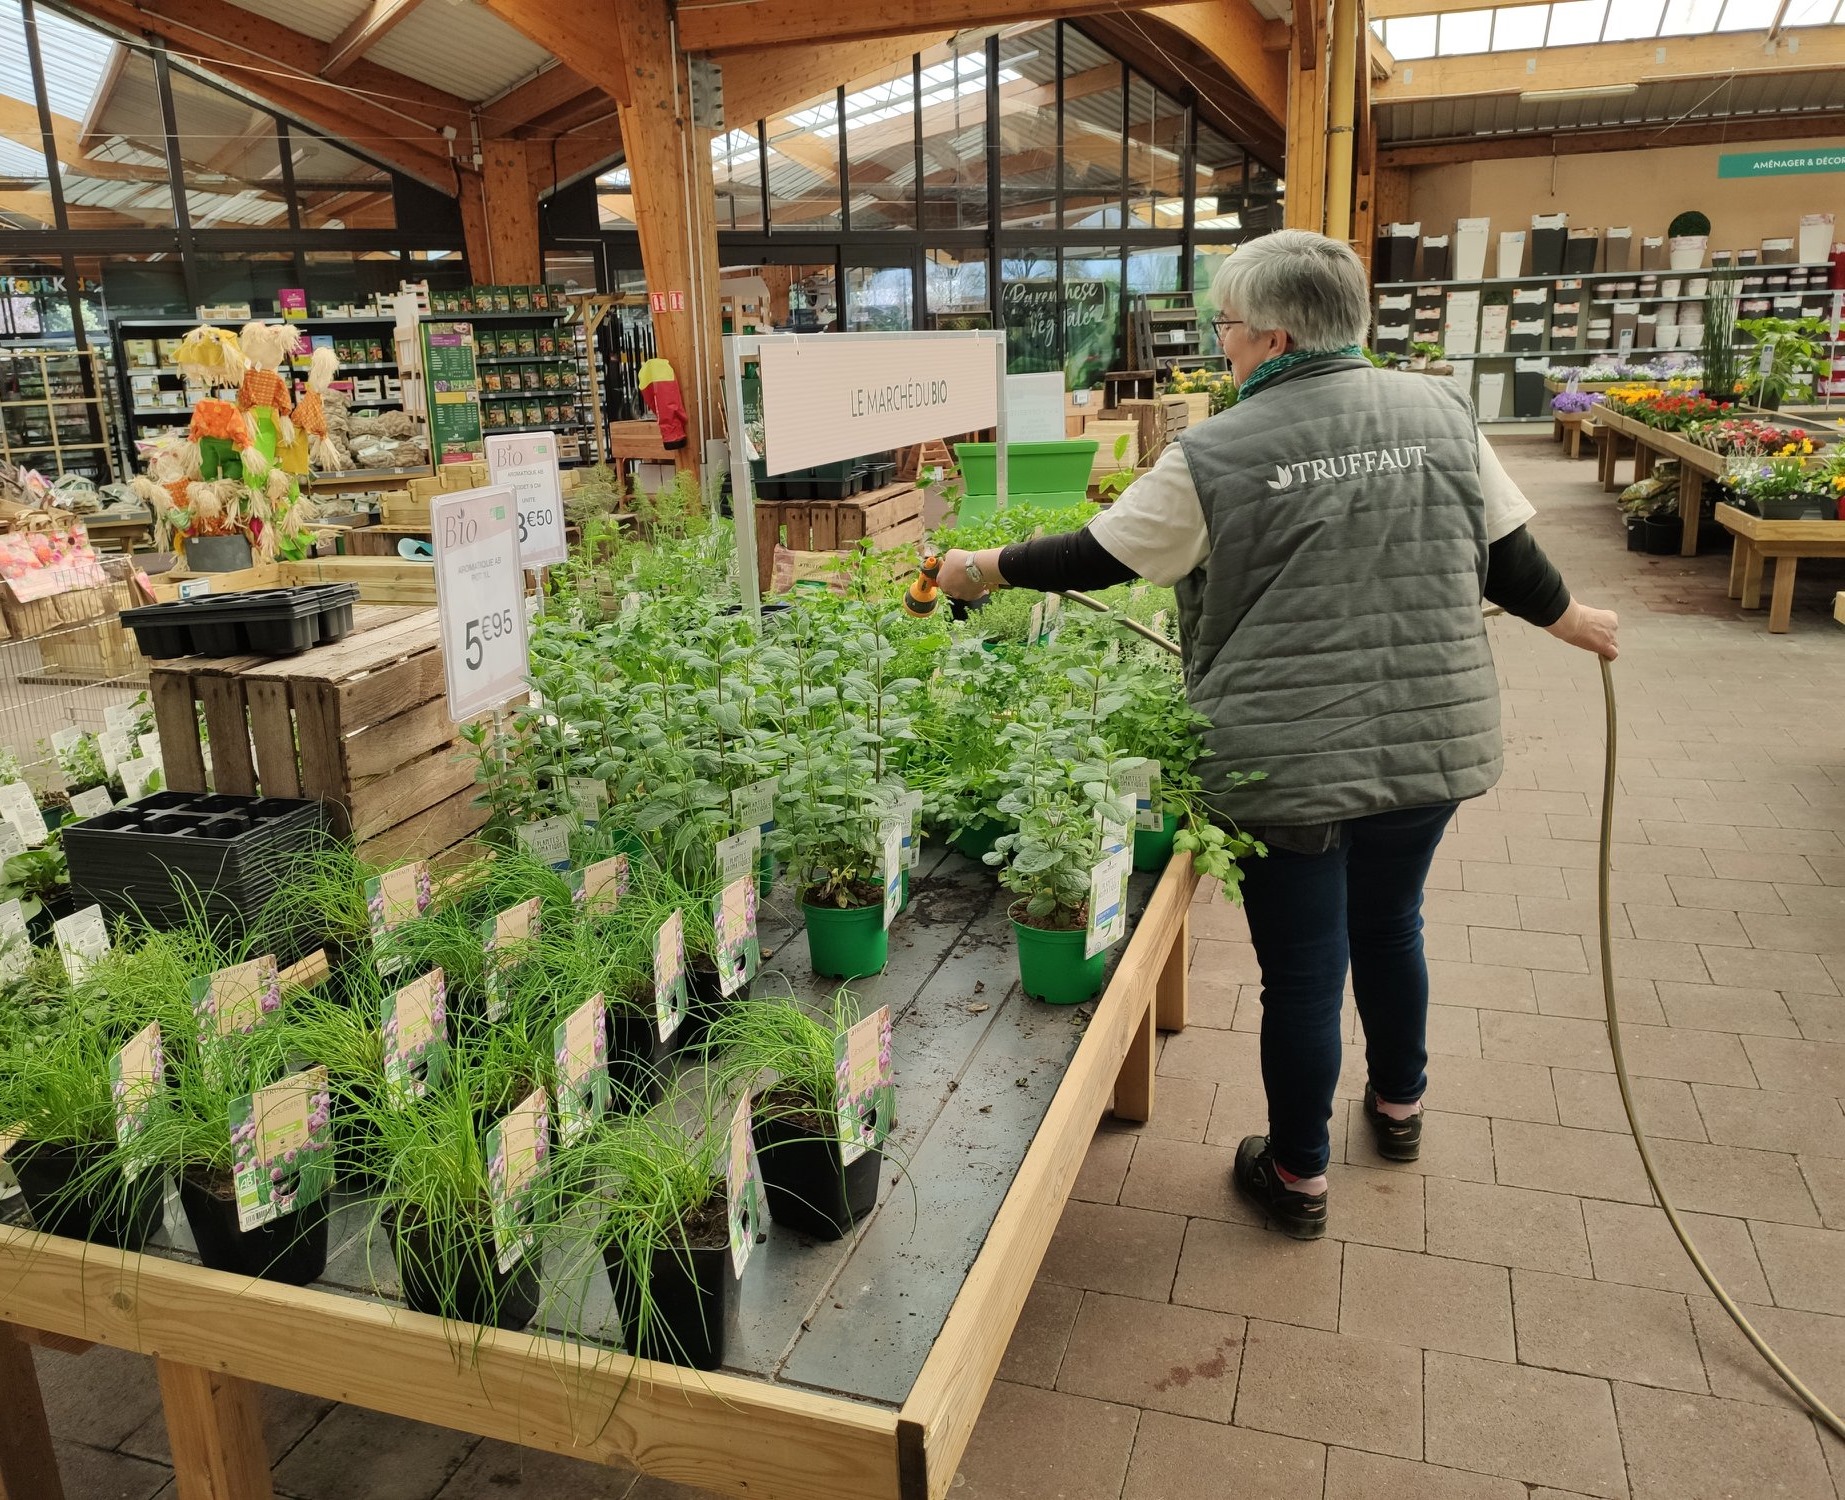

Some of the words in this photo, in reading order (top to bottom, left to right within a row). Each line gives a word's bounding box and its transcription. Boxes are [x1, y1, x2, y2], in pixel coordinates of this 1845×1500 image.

[1753, 159, 1805, 169] AMÉNAGER
[1807, 158, 1814, 166] &
[850, 390, 864, 417] LE
[867, 377, 913, 415] MARCHÉ
[915, 382, 930, 408] DU
[931, 380, 948, 405] BIO
[497, 445, 523, 468] Bio
[1291, 446, 1427, 483] TRUFFAUT
[445, 508, 477, 548] Bio
[466, 609, 513, 671] 5€95
